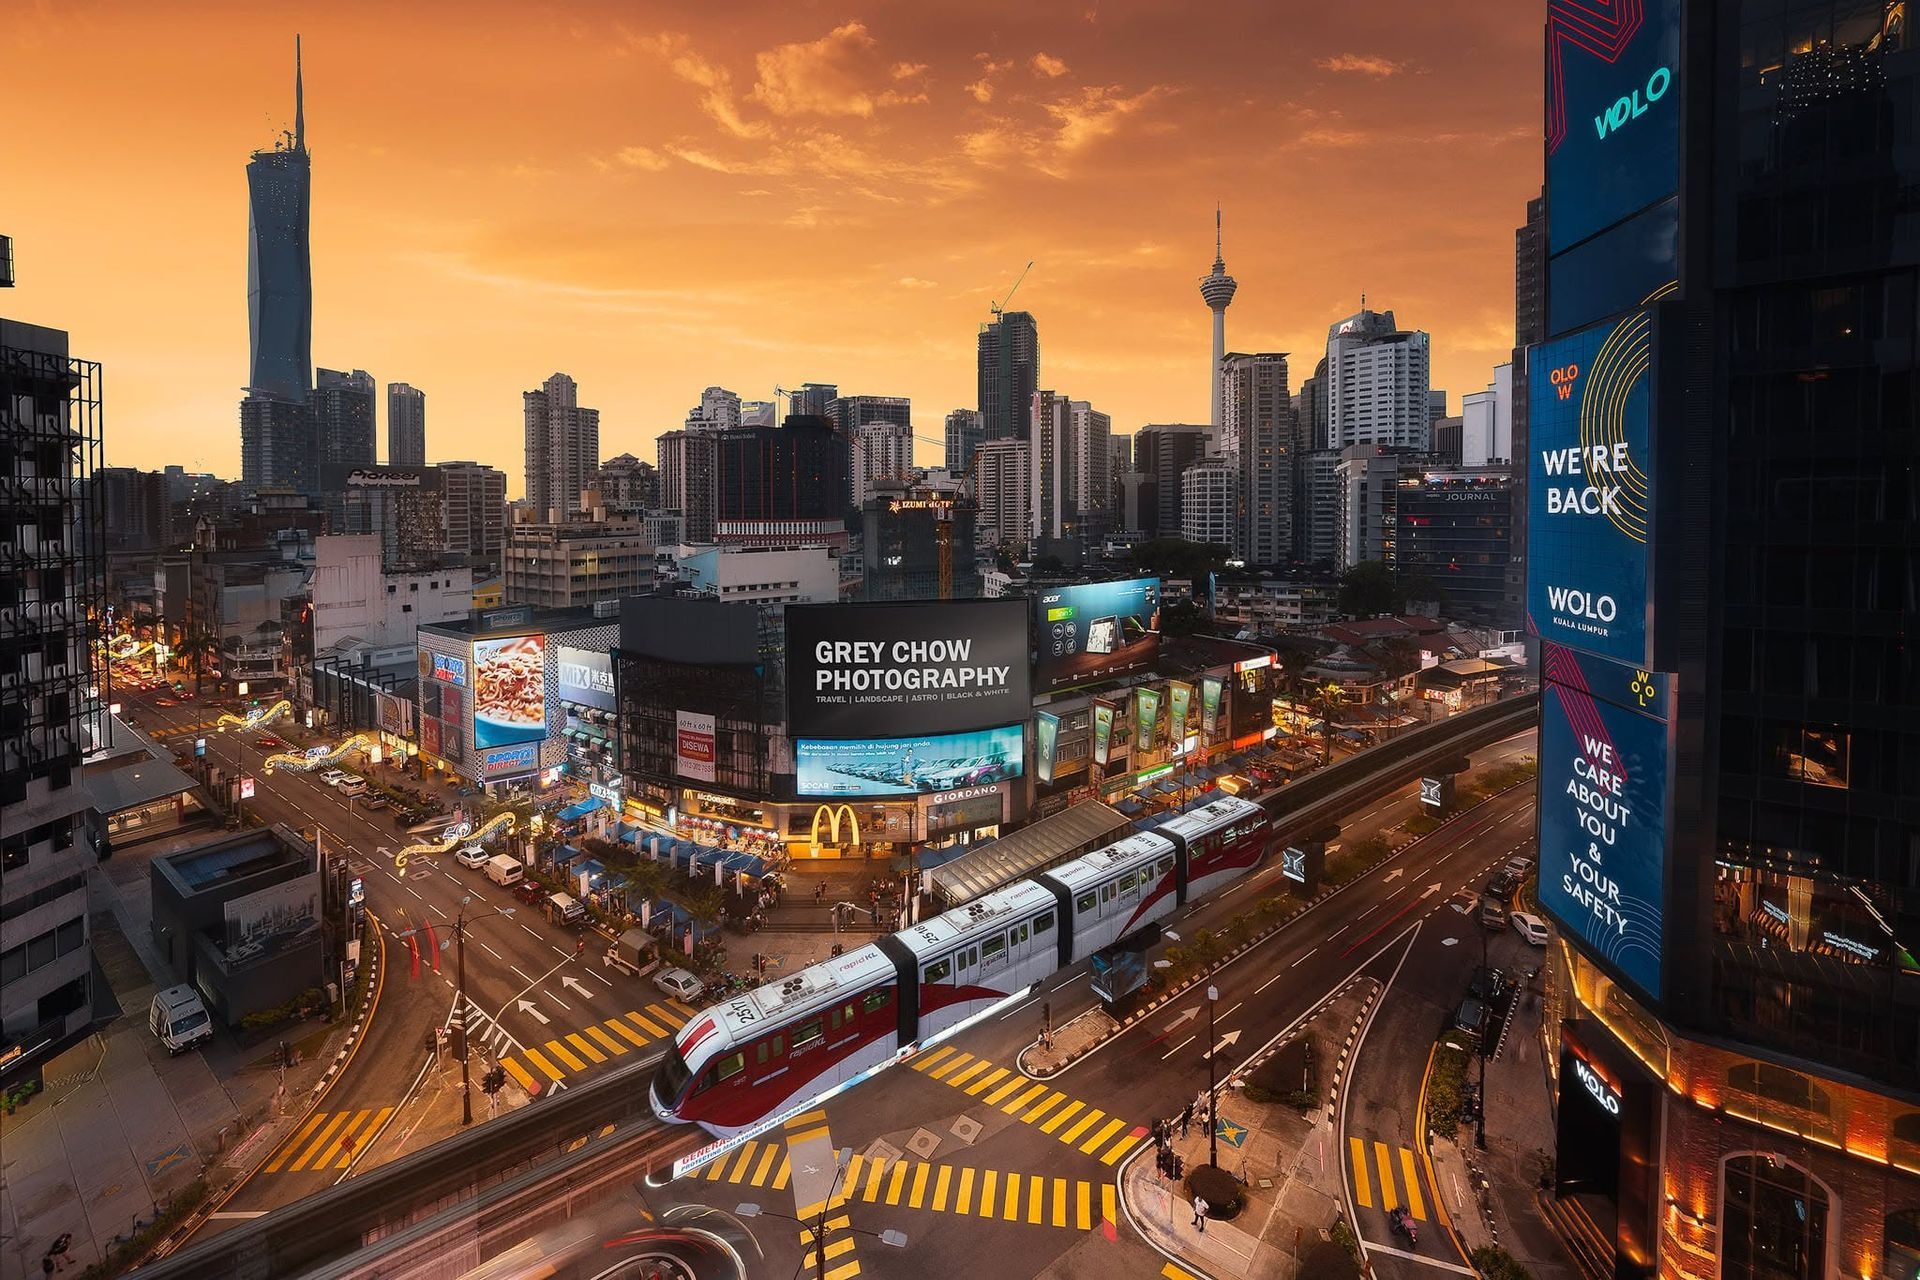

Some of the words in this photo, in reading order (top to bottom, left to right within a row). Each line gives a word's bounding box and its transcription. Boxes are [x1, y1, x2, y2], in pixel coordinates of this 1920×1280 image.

[1594, 67, 1671, 140] WOLO
[1542, 442, 1629, 476] WE'RE
[902, 500, 926, 508] IZUMI
[1445, 493, 1496, 501] JOURNAL
[1547, 485, 1622, 516] BACK
[1043, 594, 1061, 604] acer
[1548, 585, 1617, 623] WOLO
[1553, 616, 1576, 629] KUALA
[1577, 622, 1609, 638] LUMPUR
[815, 640, 886, 664] GREY
[892, 639, 972, 663] CHOW
[816, 665, 1010, 691] PHOTOGRAPHY
[855, 695, 903, 703] LANDSCAPE
[912, 694, 937, 702] ASTRO
[947, 691, 973, 700] BLACK
[984, 688, 1010, 697] WHITE
[706, 723, 712, 731] ft
[487, 747, 534, 764] SPORTS
[682, 740, 710, 753] DISEWA
[875, 743, 899, 751] hujung
[1583, 734, 1613, 765] WE
[1573, 756, 1622, 797] CARE
[934, 785, 997, 803] GIORDANO
[1566, 781, 1630, 827] ABOUT
[1577, 807, 1615, 845] YOU
[1588, 841, 1602, 866] &
[1569, 851, 1620, 905] YOUR
[1010, 884, 1039, 901] rapidKL
[1563, 874, 1628, 936] SAFETY
[914, 925, 940, 944] 2518
[840, 952, 878, 972] rapidKL
[731, 1001, 755, 1024] 2517
[789, 1036, 826, 1060] rapidKL
[681, 1149, 722, 1171] PROTECTING
[722, 1127, 764, 1151] MALAYSIANS
[764, 1120, 777, 1130] FOR
